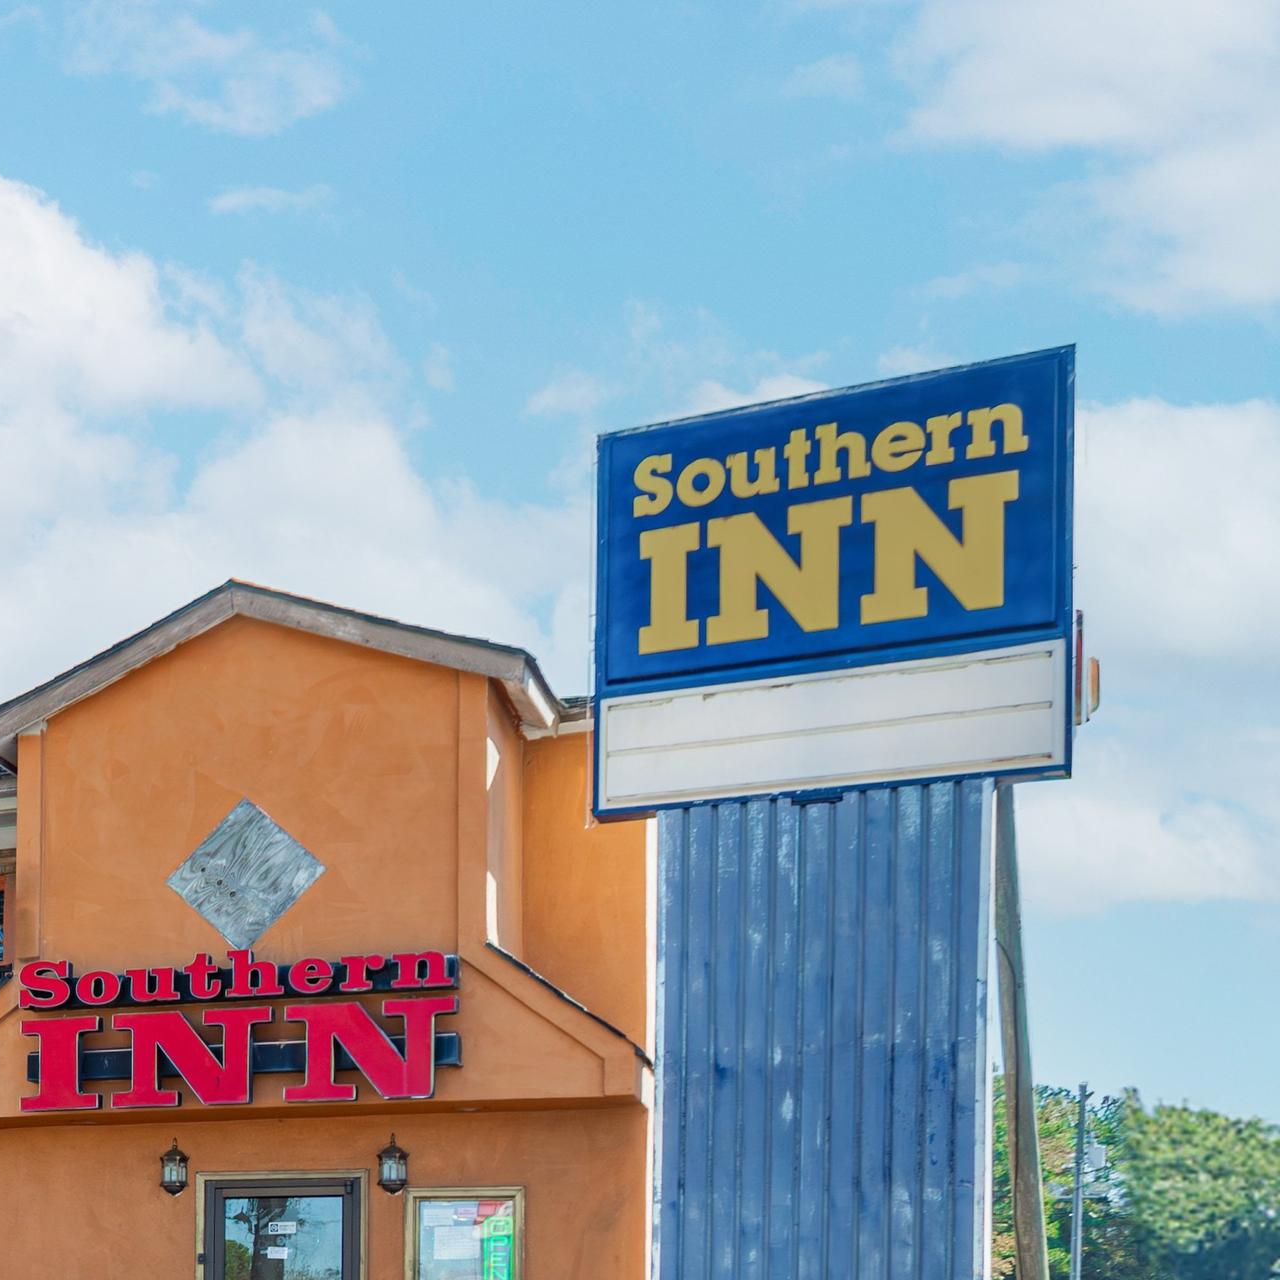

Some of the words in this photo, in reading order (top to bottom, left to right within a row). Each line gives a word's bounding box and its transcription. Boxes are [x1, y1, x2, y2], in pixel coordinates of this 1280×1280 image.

[633, 402, 1029, 518] Southern
[638, 469, 1020, 655] INN
[18, 949, 453, 1009] Southern
[19, 996, 458, 1111] INN
